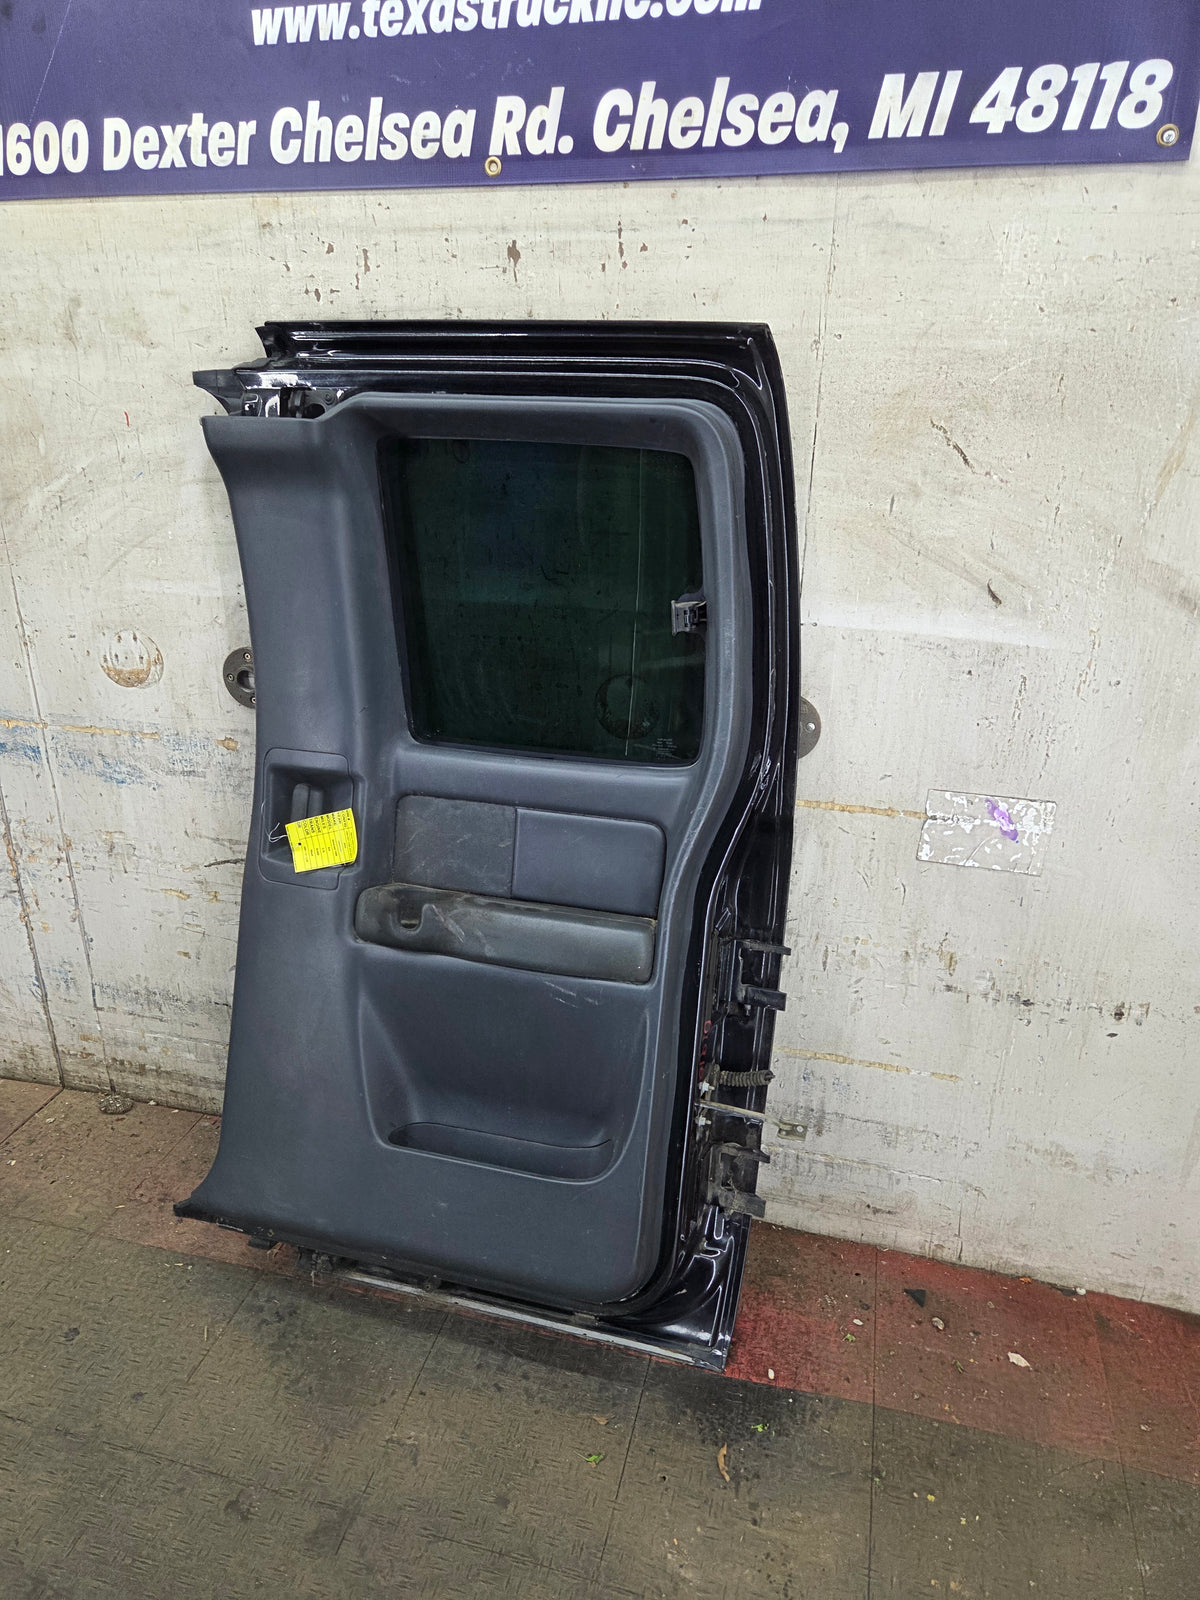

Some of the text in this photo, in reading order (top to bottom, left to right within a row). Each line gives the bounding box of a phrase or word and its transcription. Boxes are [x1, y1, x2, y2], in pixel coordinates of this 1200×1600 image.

[251, 0, 762, 46] www.texastrucc.
[0, 58, 1174, 177] 600 Dexter Chelsea Rd. Chelsea, MI 48118
